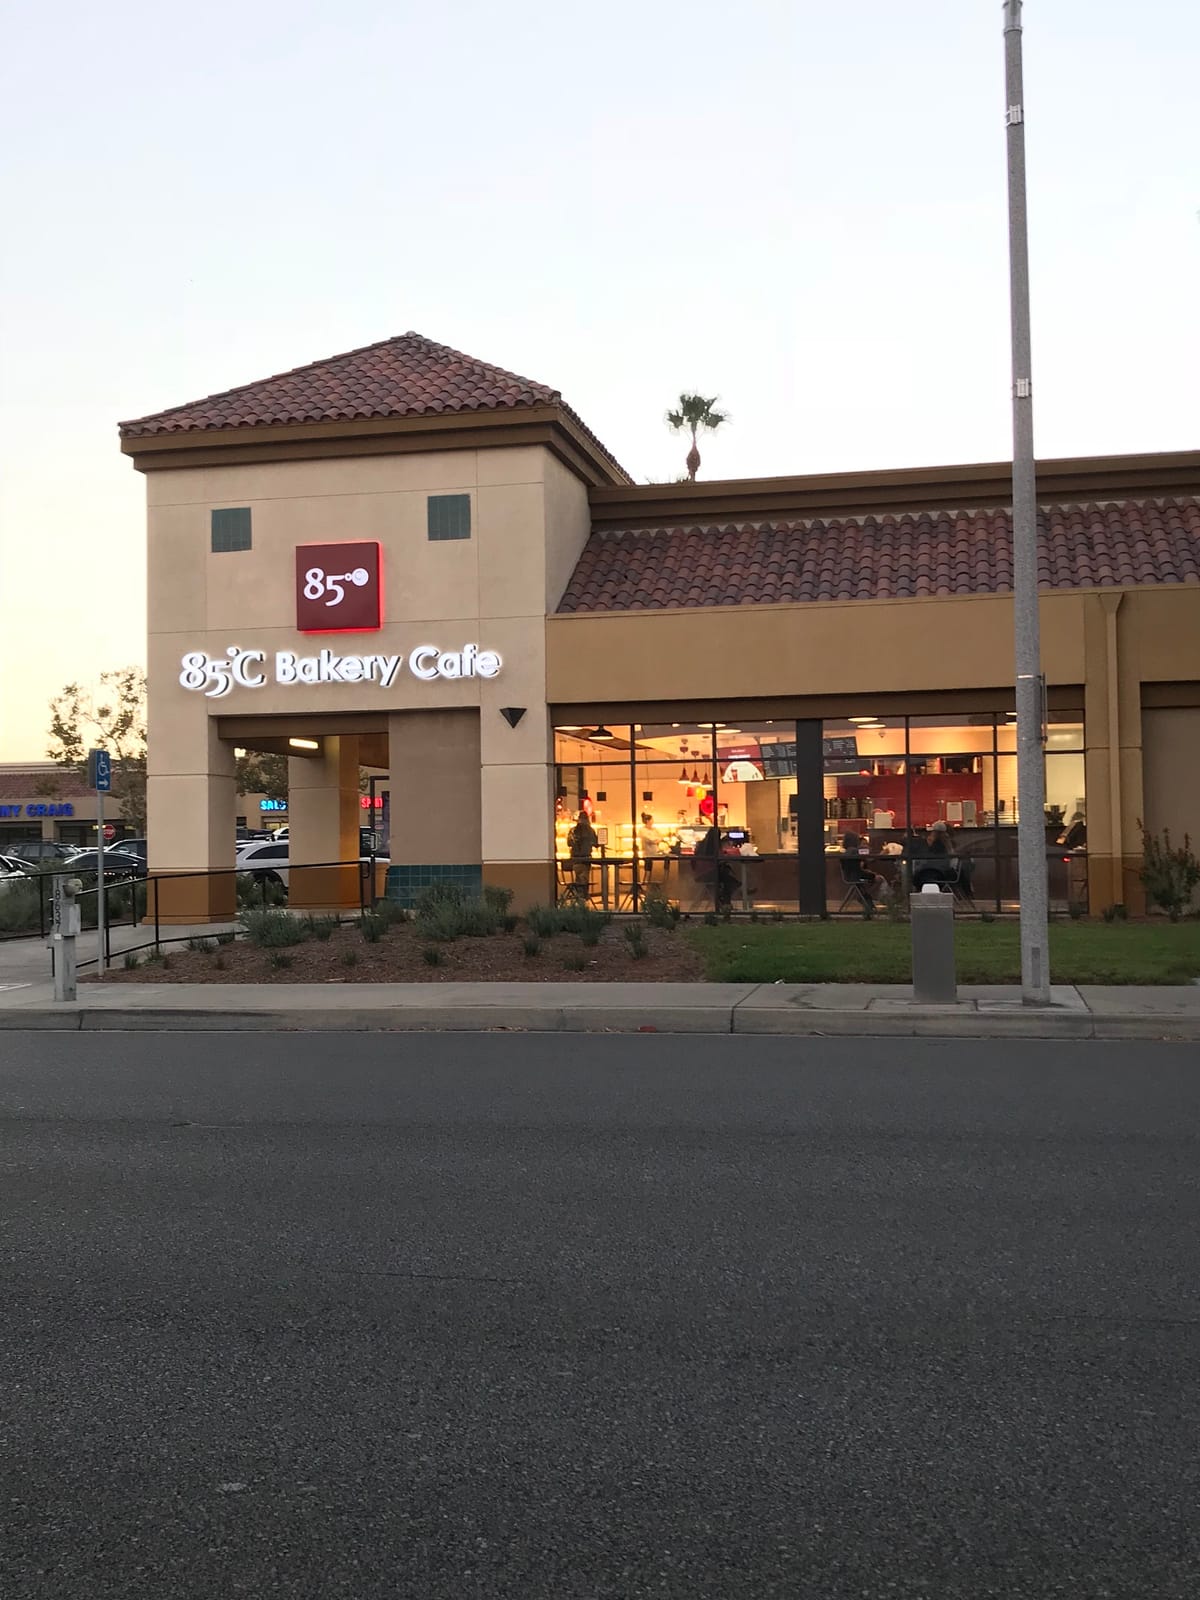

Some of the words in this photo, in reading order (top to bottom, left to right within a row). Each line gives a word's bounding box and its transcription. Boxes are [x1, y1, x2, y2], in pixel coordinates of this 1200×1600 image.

[275, 649, 401, 687] Bakery
[409, 643, 501, 678] Cafe
[26, 803, 73, 817] CRAIG
